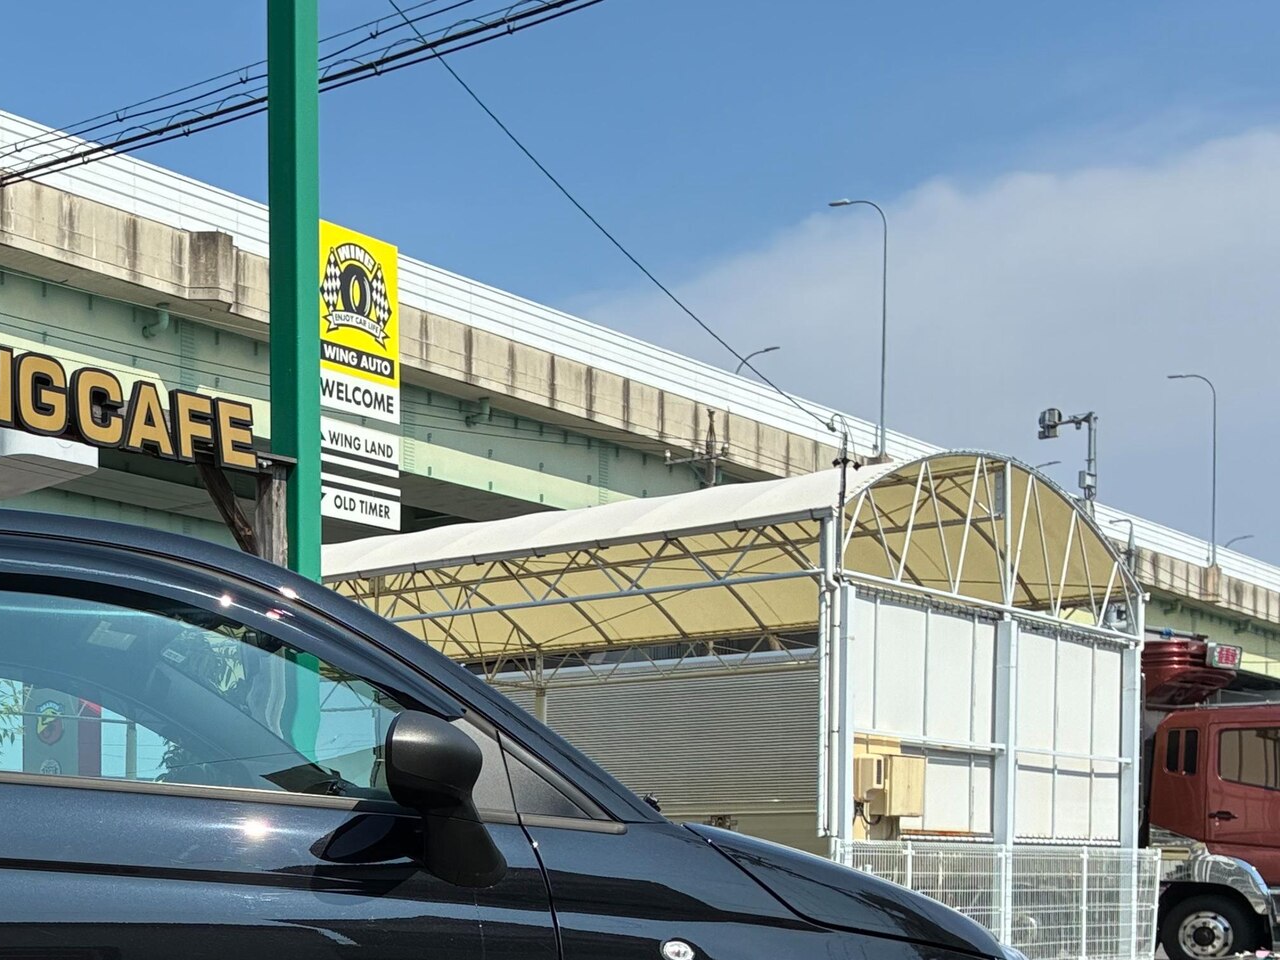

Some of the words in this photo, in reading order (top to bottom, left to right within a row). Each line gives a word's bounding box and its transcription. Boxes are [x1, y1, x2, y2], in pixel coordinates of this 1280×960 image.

[336, 244, 377, 273] WING
[334, 312, 354, 323] ENJOY
[354, 316, 368, 328] CAR
[367, 321, 380, 333] LIFE
[323, 343, 358, 366] WING
[360, 354, 392, 376] AUTO
[320, 377, 395, 414] WELCOME
[328, 429, 362, 451] WING
[364, 438, 394, 459] LAND
[333, 494, 357, 512] OLD
[358, 499, 391, 520] TIMER
